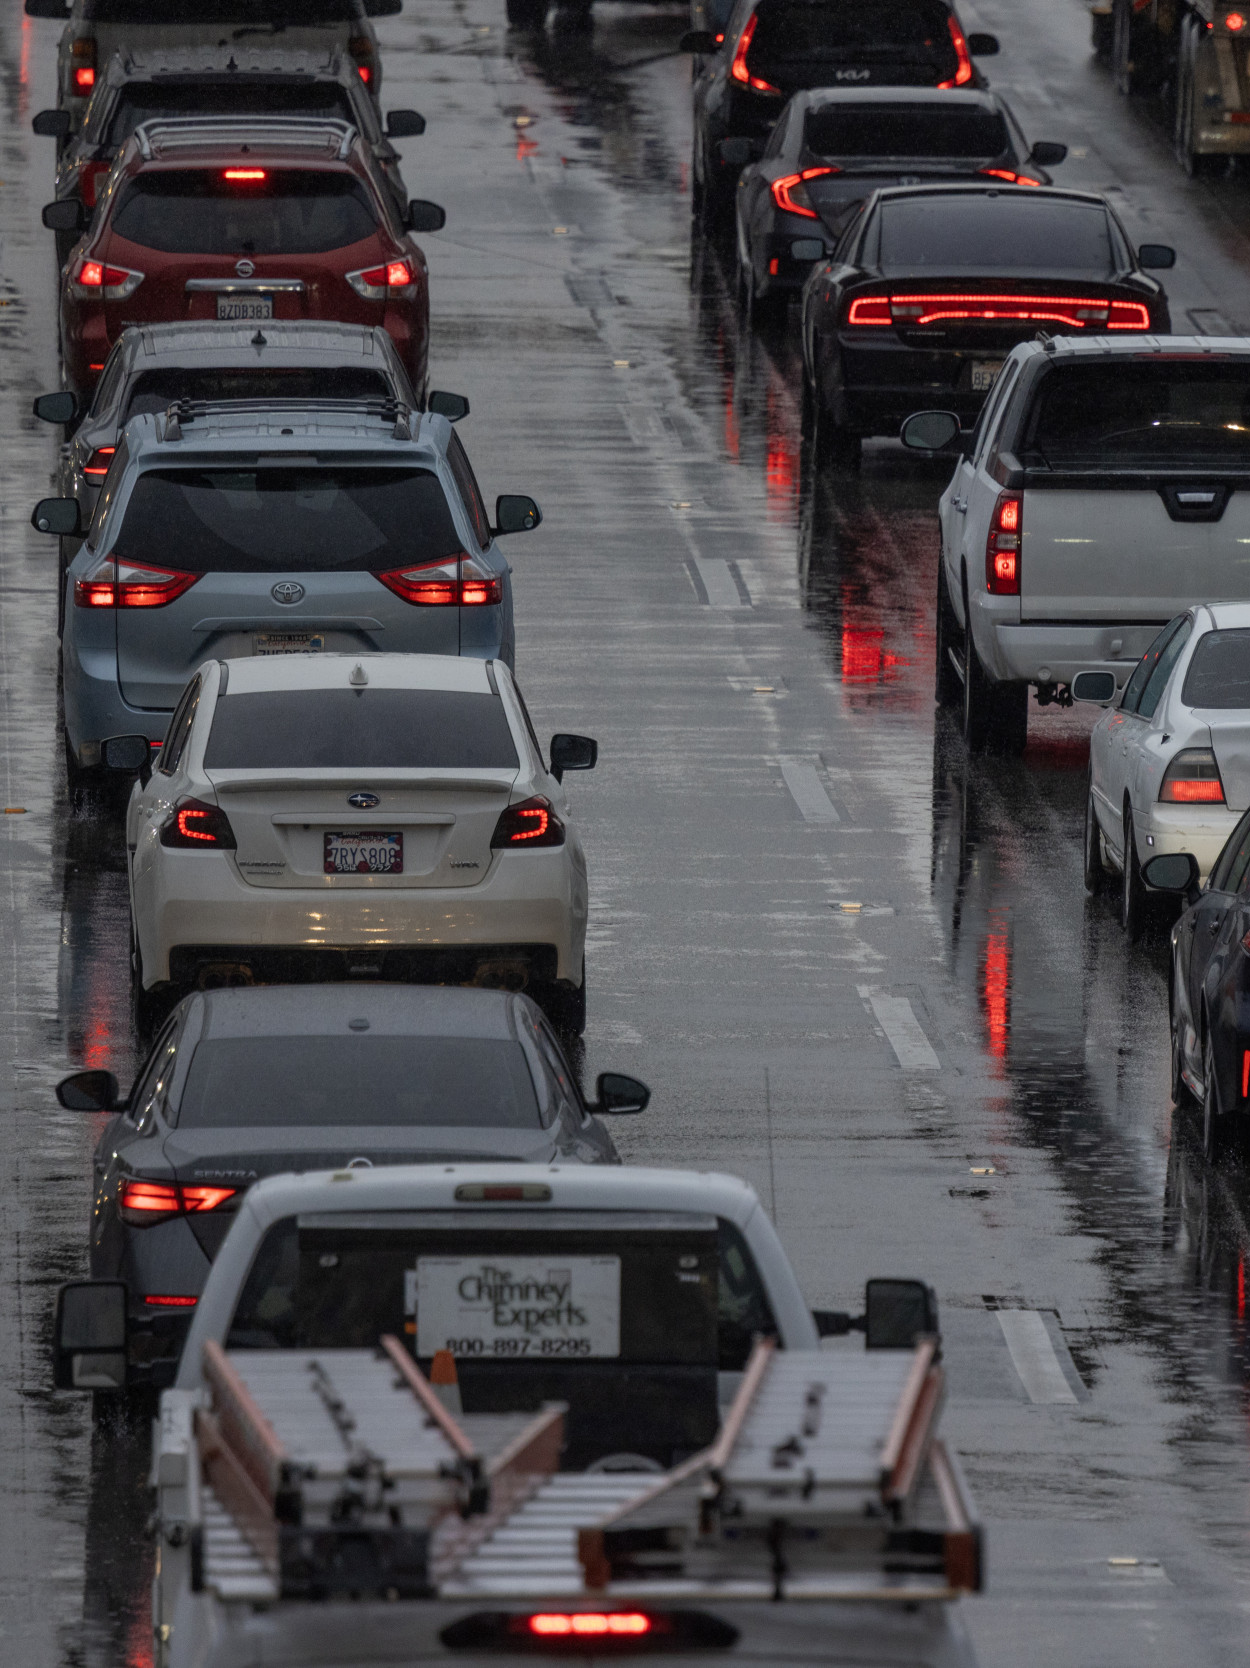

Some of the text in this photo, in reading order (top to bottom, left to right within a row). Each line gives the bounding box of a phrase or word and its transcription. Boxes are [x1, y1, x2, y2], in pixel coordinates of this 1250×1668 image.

[193, 1169, 258, 1179] SENTRA
[482, 1265, 512, 1284] The
[458, 1275, 570, 1306] Chimney
[494, 1302, 588, 1334] Experts
[446, 1338, 592, 1356] 800-897-8295
